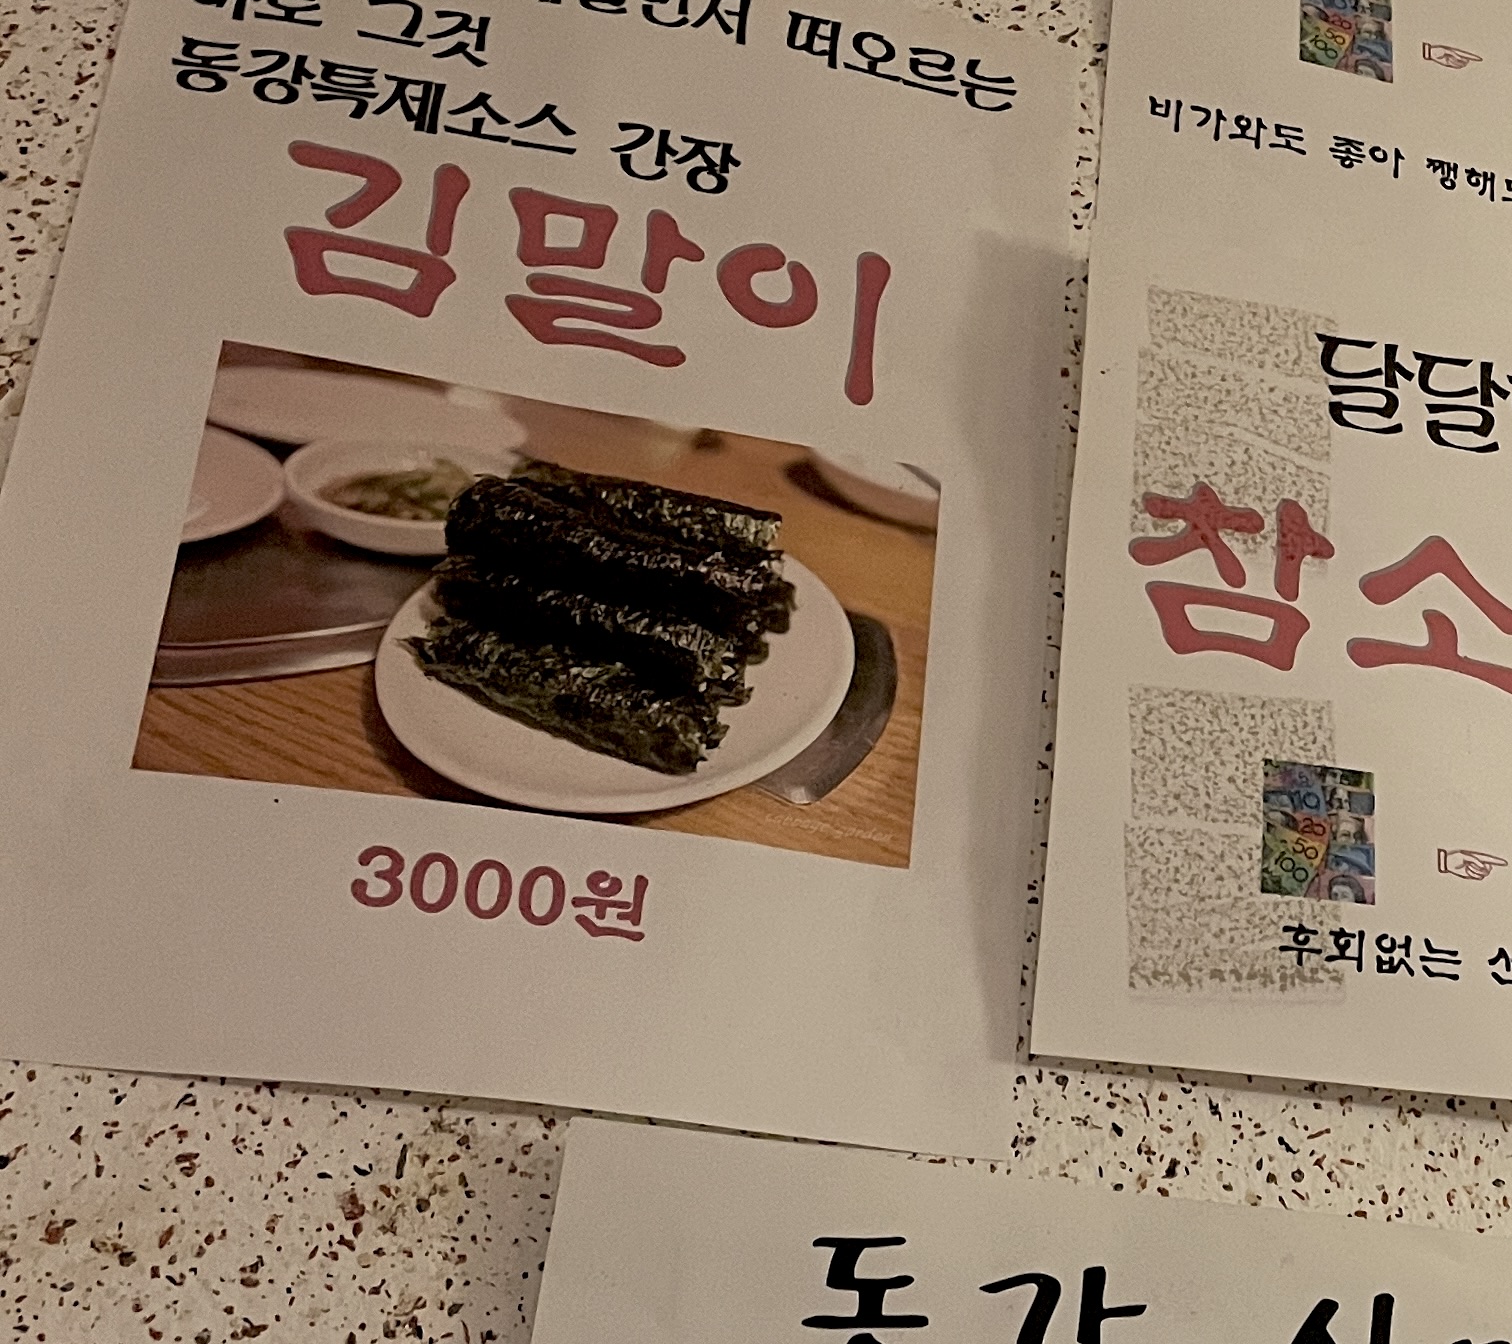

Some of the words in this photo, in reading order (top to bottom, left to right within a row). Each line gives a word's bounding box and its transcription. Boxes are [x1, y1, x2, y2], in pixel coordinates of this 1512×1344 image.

[786, 9, 1018, 112] 떠오르는
[171, 35, 577, 156] 동강특제소스
[610, 122, 741, 194] 간장
[1149, 96, 1306, 155] 비가와도
[1329, 136, 1405, 178] 좋아
[283, 140, 892, 406] 김말이
[351, 846, 648, 942] 3000원
[1280, 922, 1463, 982] 후회없는
